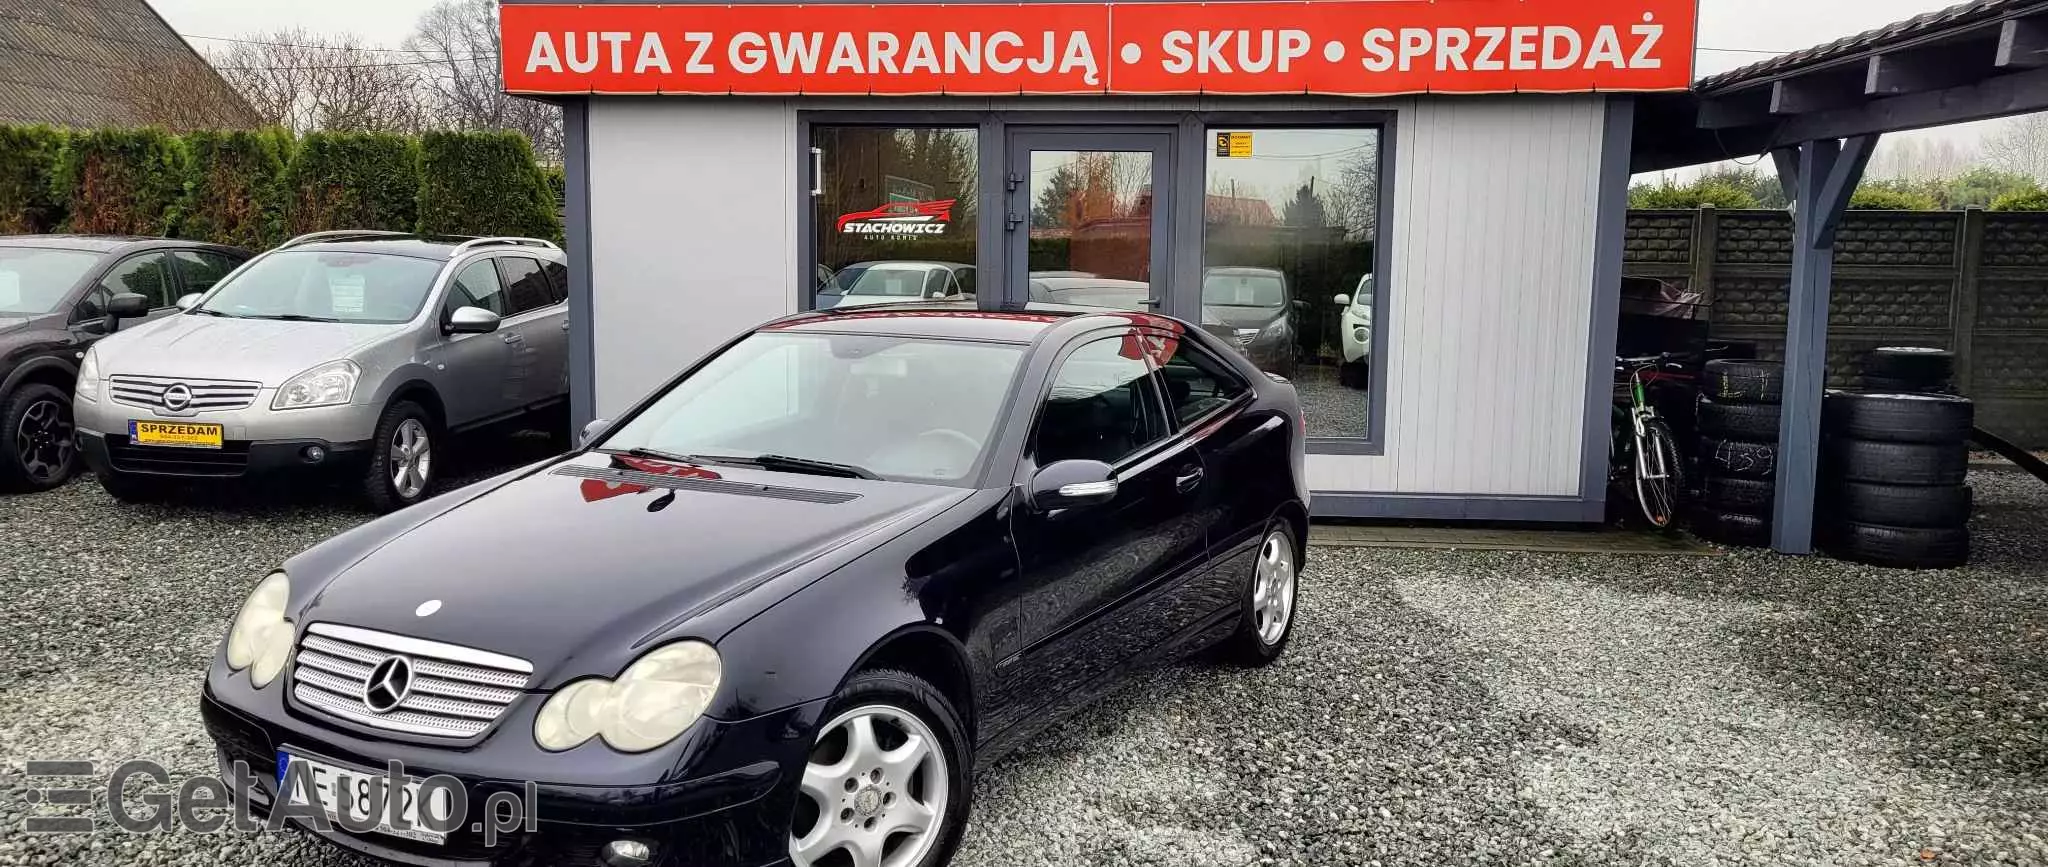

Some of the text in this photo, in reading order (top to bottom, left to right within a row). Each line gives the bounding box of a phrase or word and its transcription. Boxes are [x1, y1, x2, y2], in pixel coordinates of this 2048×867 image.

[525, 11, 1664, 86] AUTA Z GWARANCJĄ SKUP SPRZEDAŻ
[843, 222, 946, 234] STACHOWICZ
[141, 424, 217, 436] SPRZEDAM
